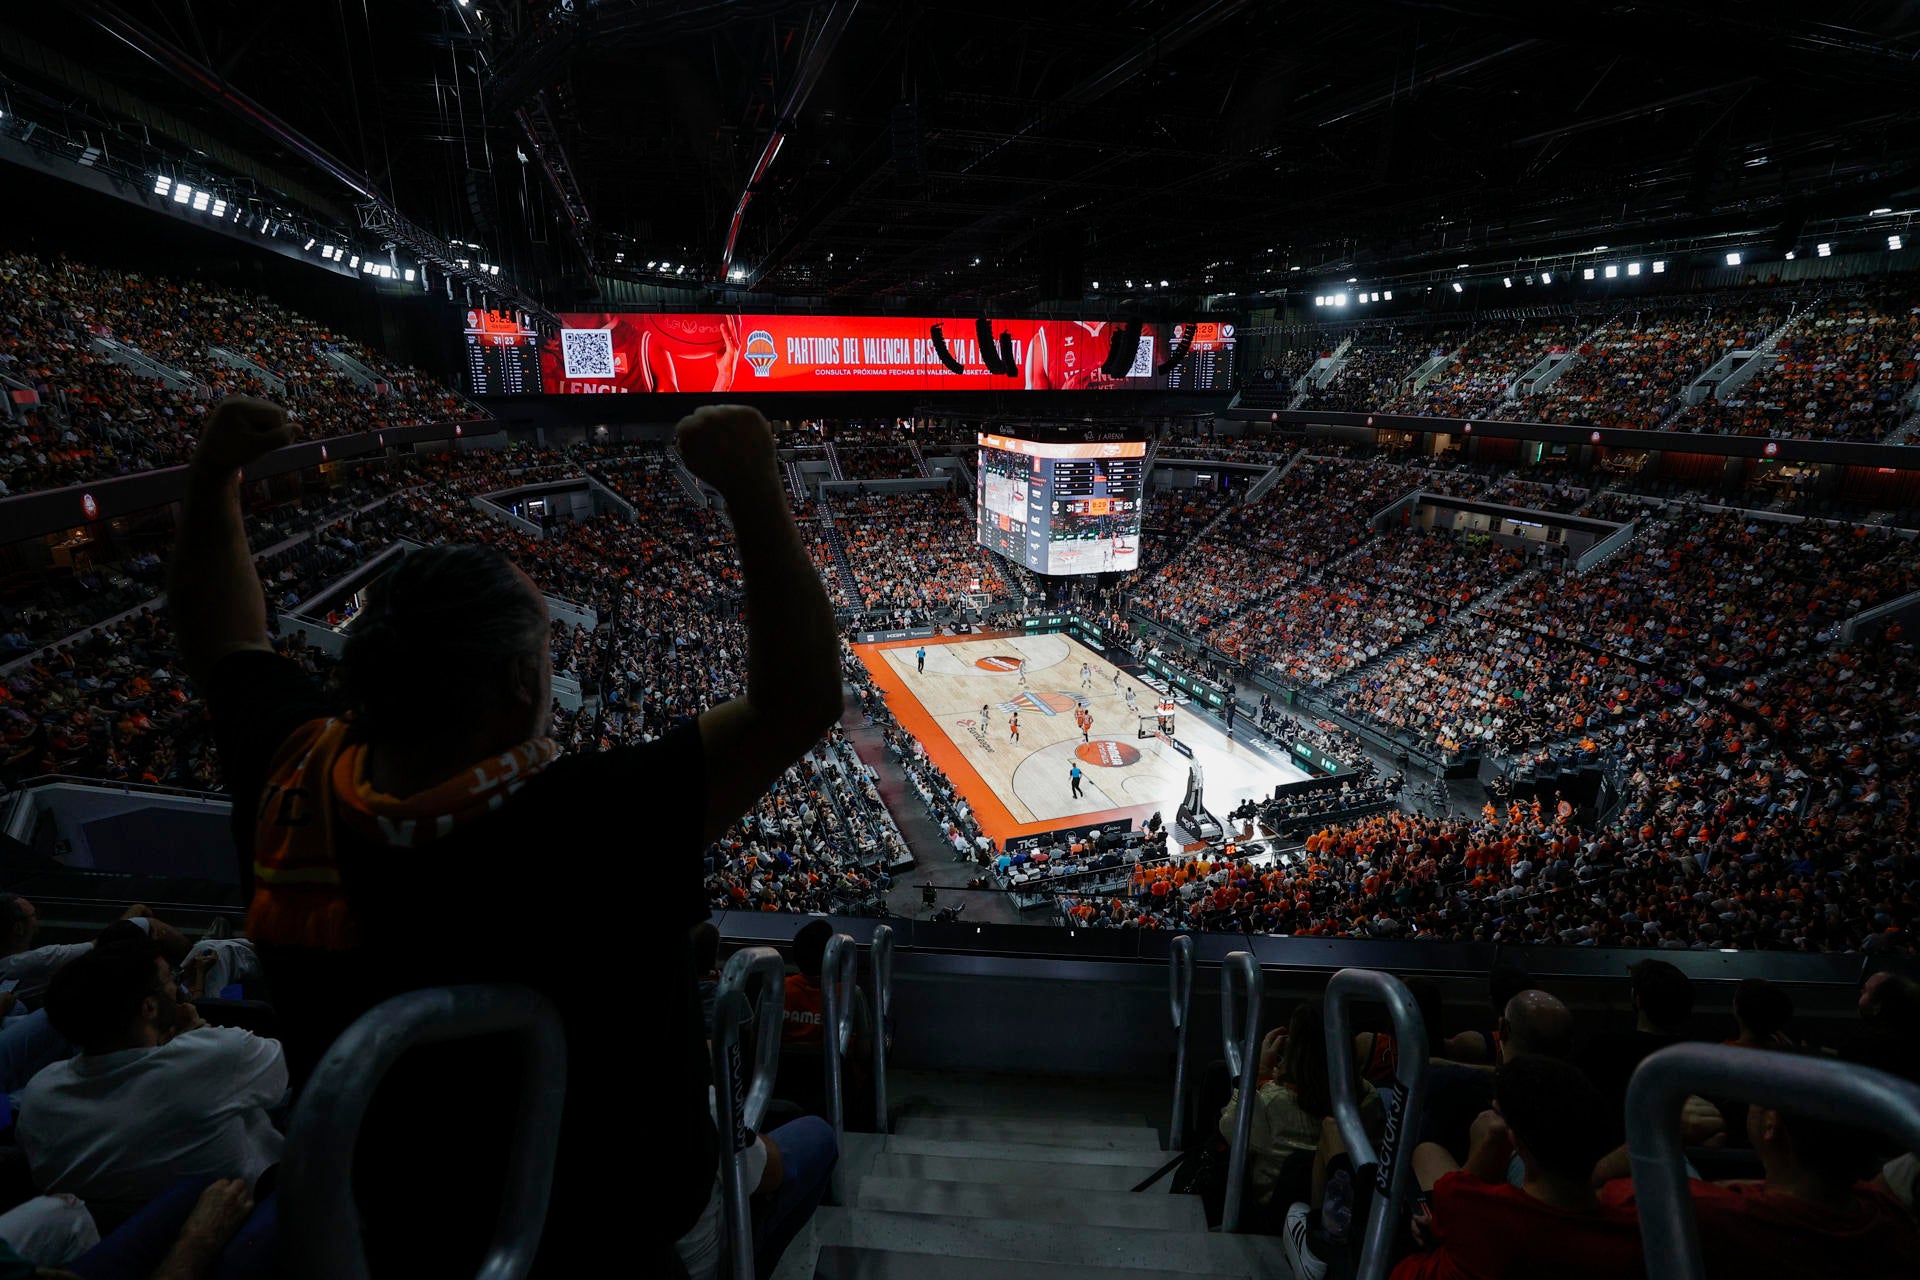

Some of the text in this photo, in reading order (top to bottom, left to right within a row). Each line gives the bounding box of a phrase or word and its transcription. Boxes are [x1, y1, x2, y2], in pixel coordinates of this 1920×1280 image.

[504, 336, 514, 345] 23
[786, 336, 840, 365] PARTIDOS
[843, 337, 860, 365] DEL
[863, 337, 911, 365] VALENCIA
[953, 339, 966, 365] YA
[969, 339, 976, 365] A
[853, 367, 887, 375] PRÓXIMAS
[1066, 504, 1074, 512] 31
[1124, 502, 1133, 510] 23
[1018, 837, 1039, 850] TKE
[1226, 845, 1236, 855] 22
[783, 1009, 825, 1025] PAME
